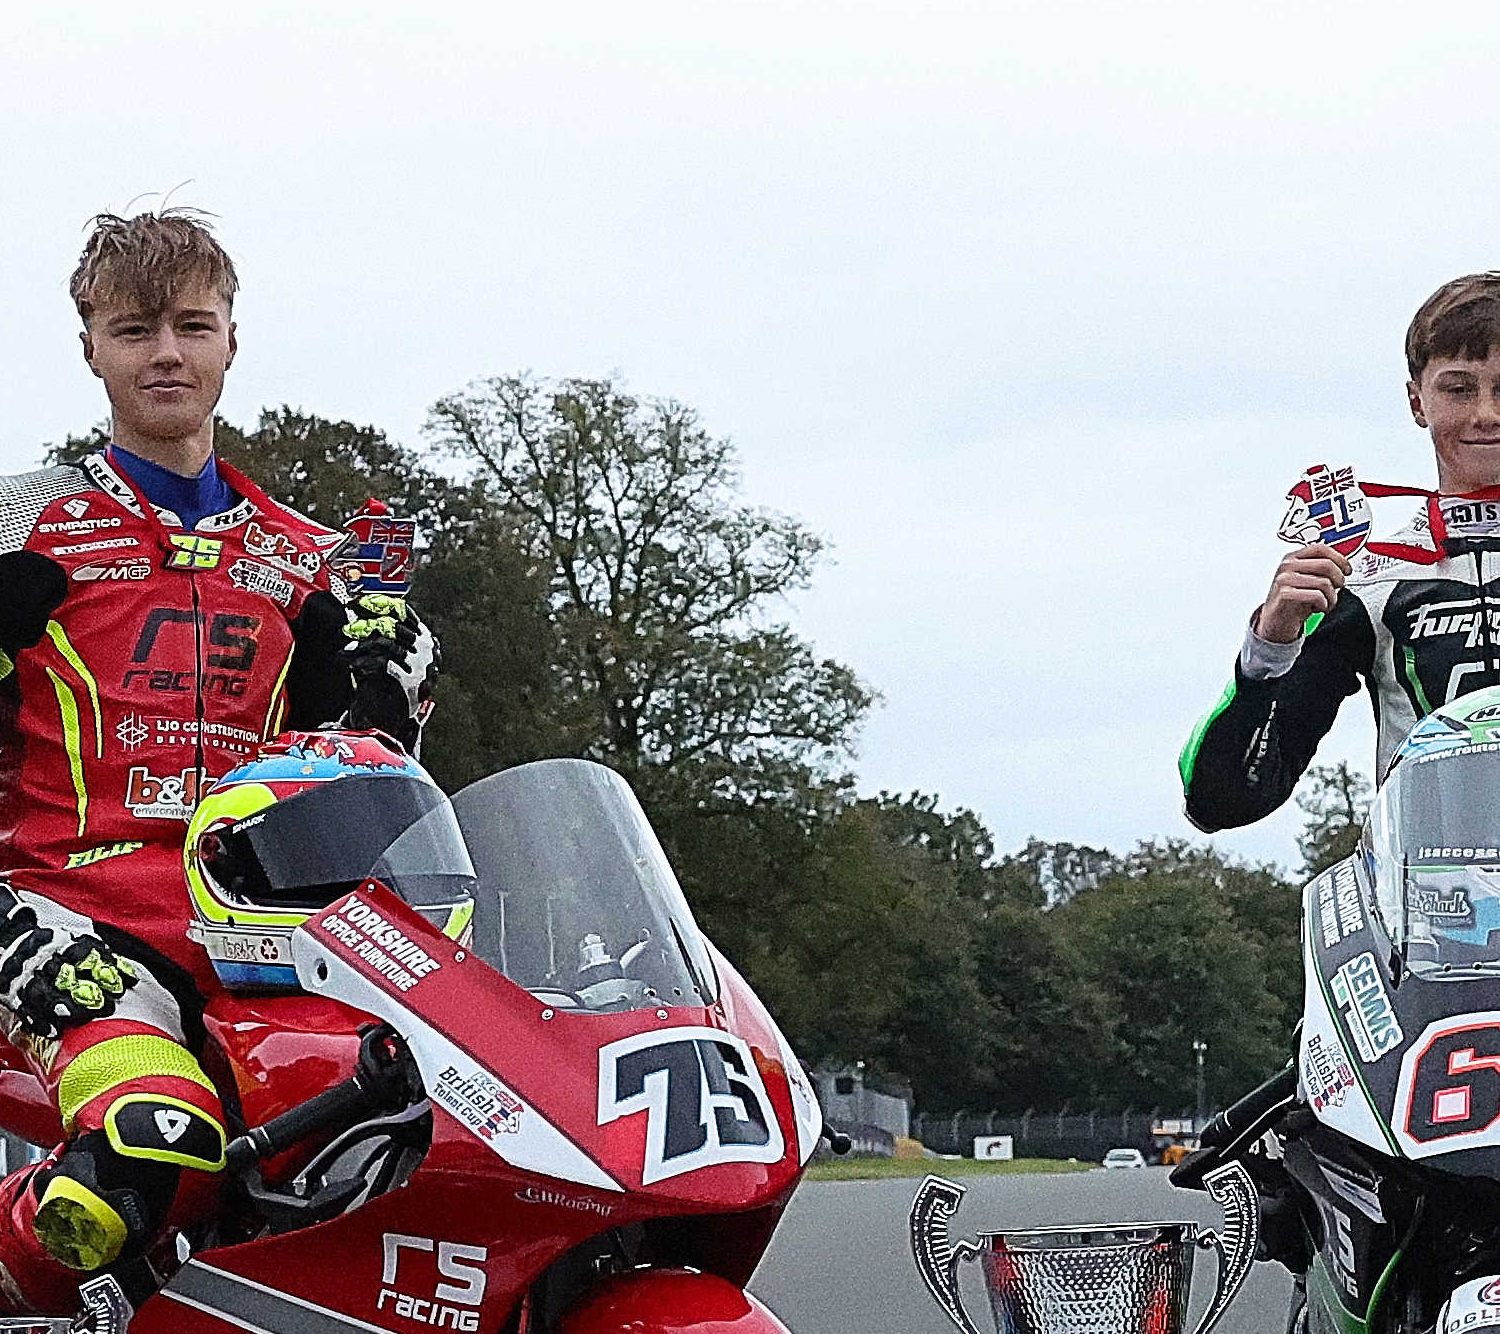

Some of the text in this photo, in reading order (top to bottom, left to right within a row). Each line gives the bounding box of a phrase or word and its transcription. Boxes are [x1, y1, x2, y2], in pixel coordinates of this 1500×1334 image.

[38, 518, 121, 533] SYMPATICO
[321, 914, 420, 993] OFFICE FURNITURE
[337, 895, 442, 979] YORKSHIRE
[1348, 953, 1400, 1051] SEMMS
[1308, 1034, 1336, 1090] British
[438, 1065, 496, 1116] British
[460, 1104, 482, 1127] Cup
